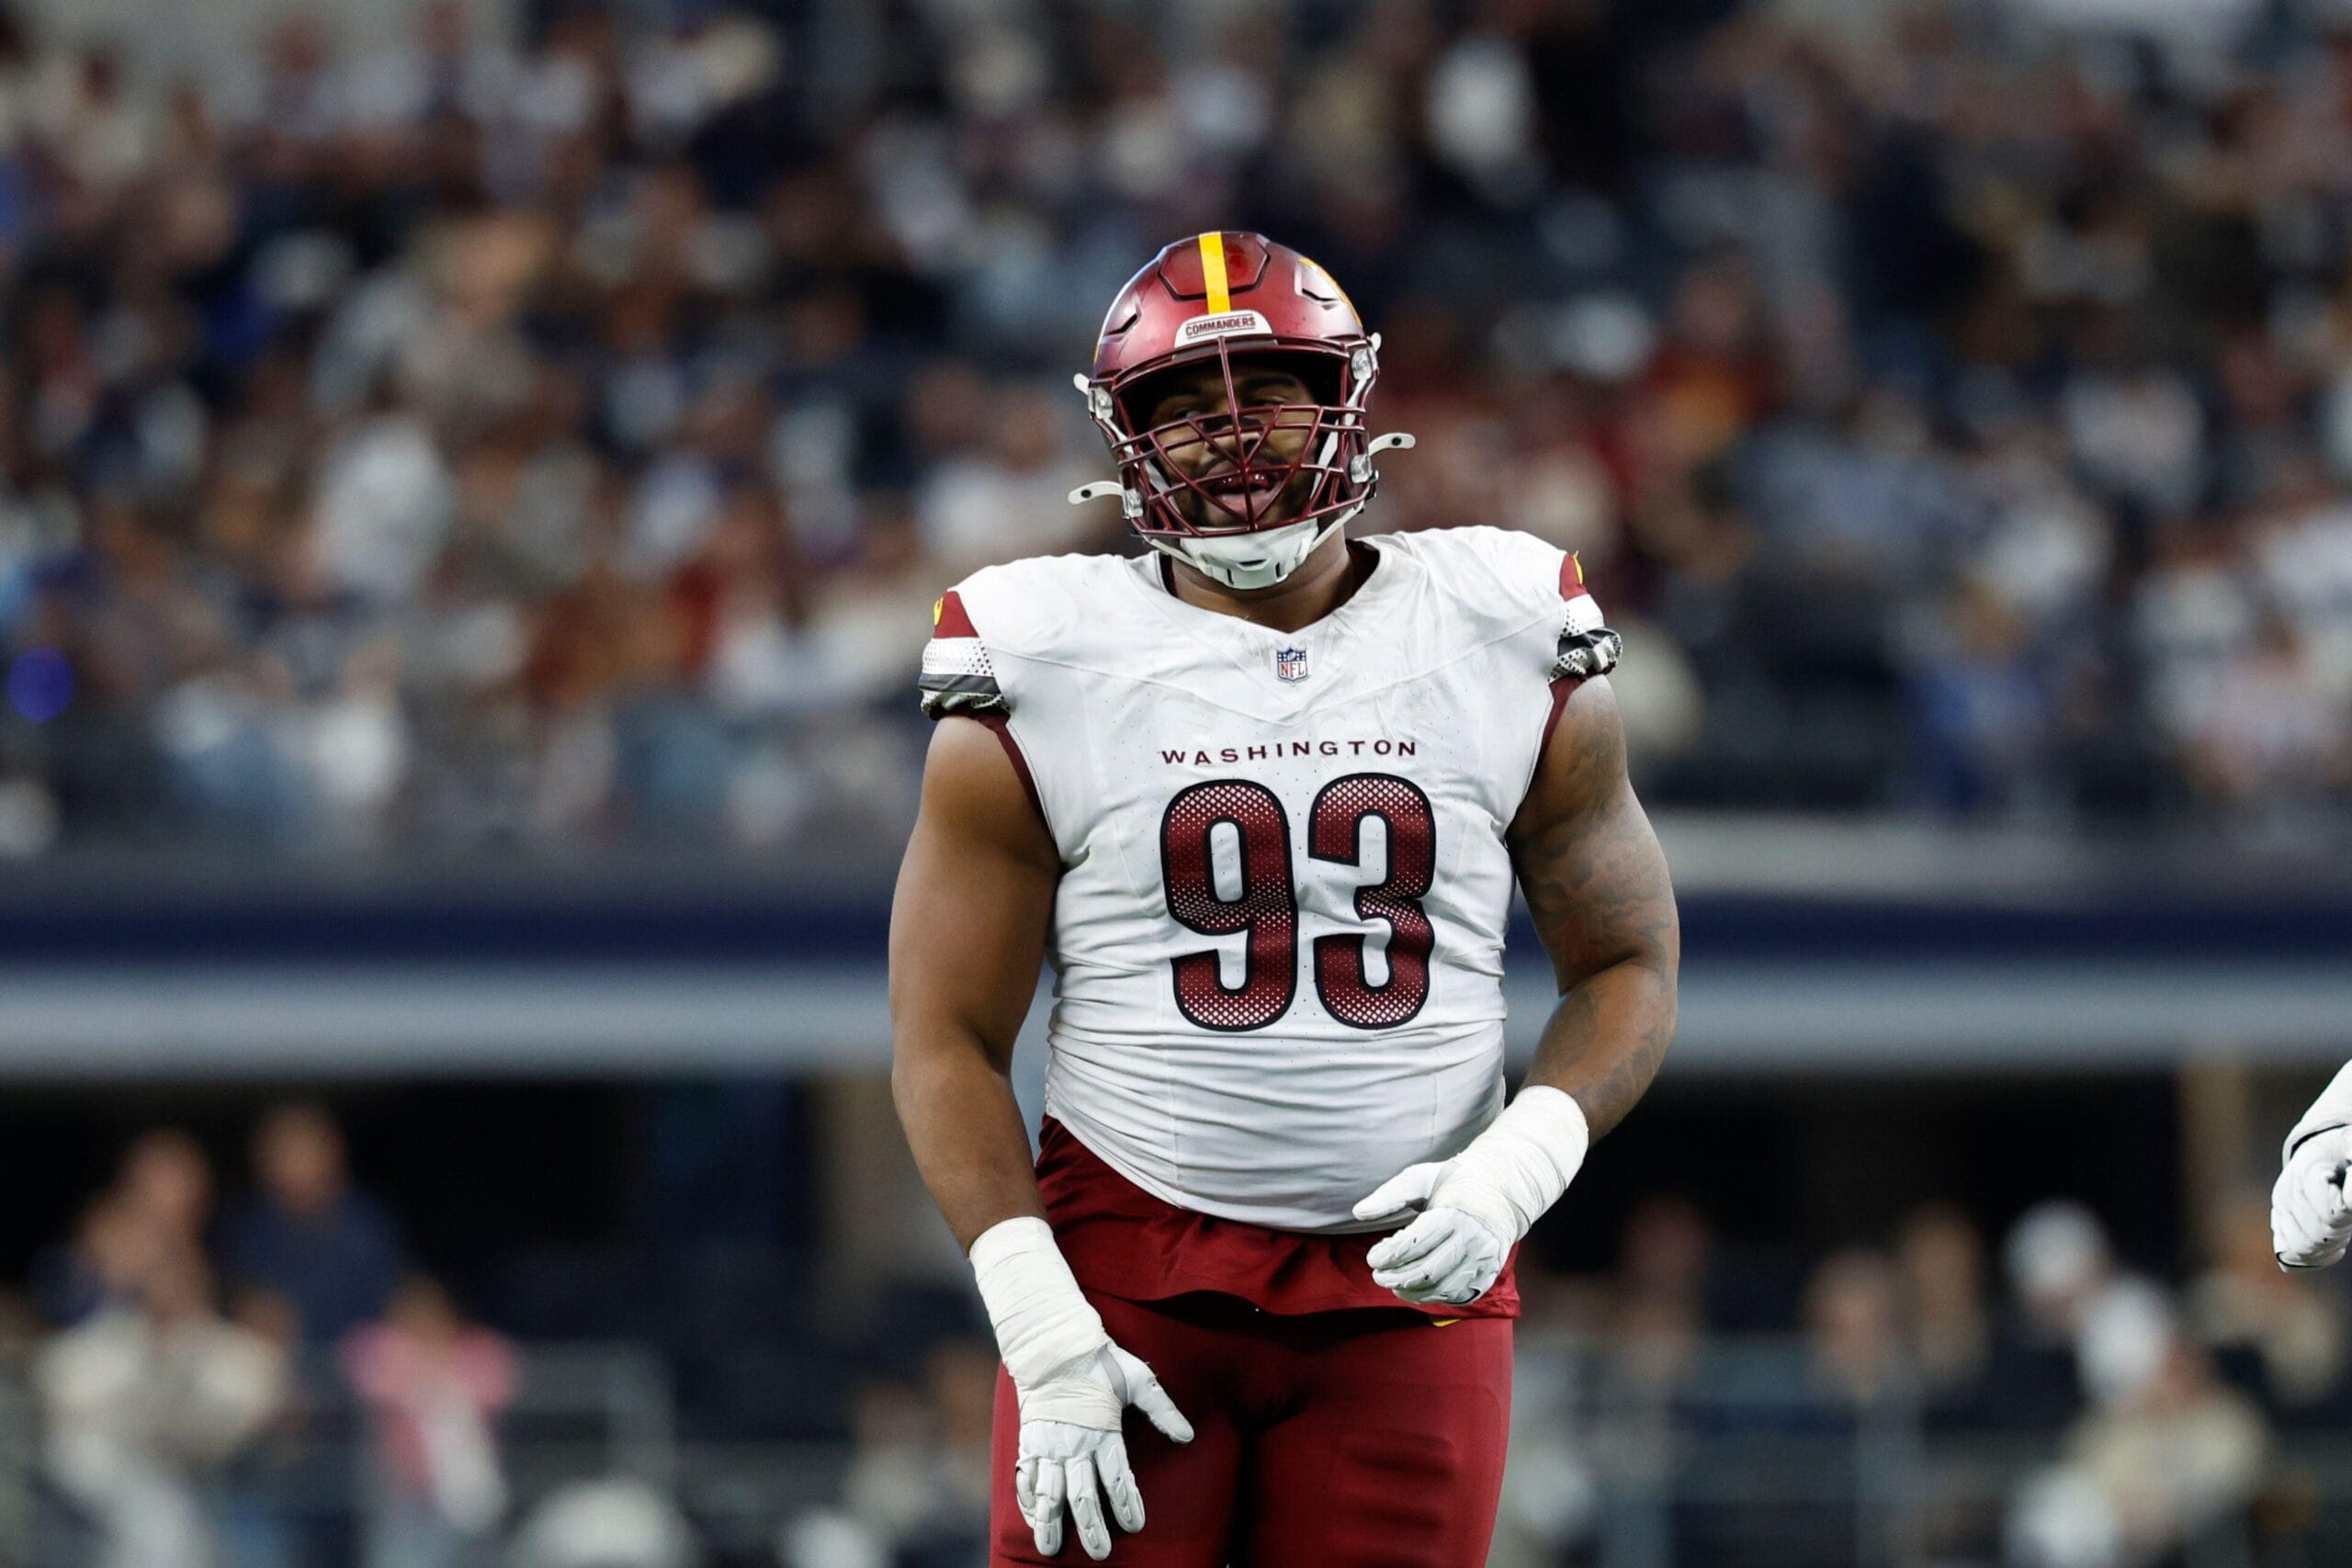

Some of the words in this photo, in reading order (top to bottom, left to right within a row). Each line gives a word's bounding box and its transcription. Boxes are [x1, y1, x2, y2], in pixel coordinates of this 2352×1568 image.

[1185, 316, 1256, 336] COMMANDERS
[1281, 662, 1305, 678] NFL
[1161, 739, 1417, 765] WASHINGTON
[1159, 772, 1437, 1032] 93
